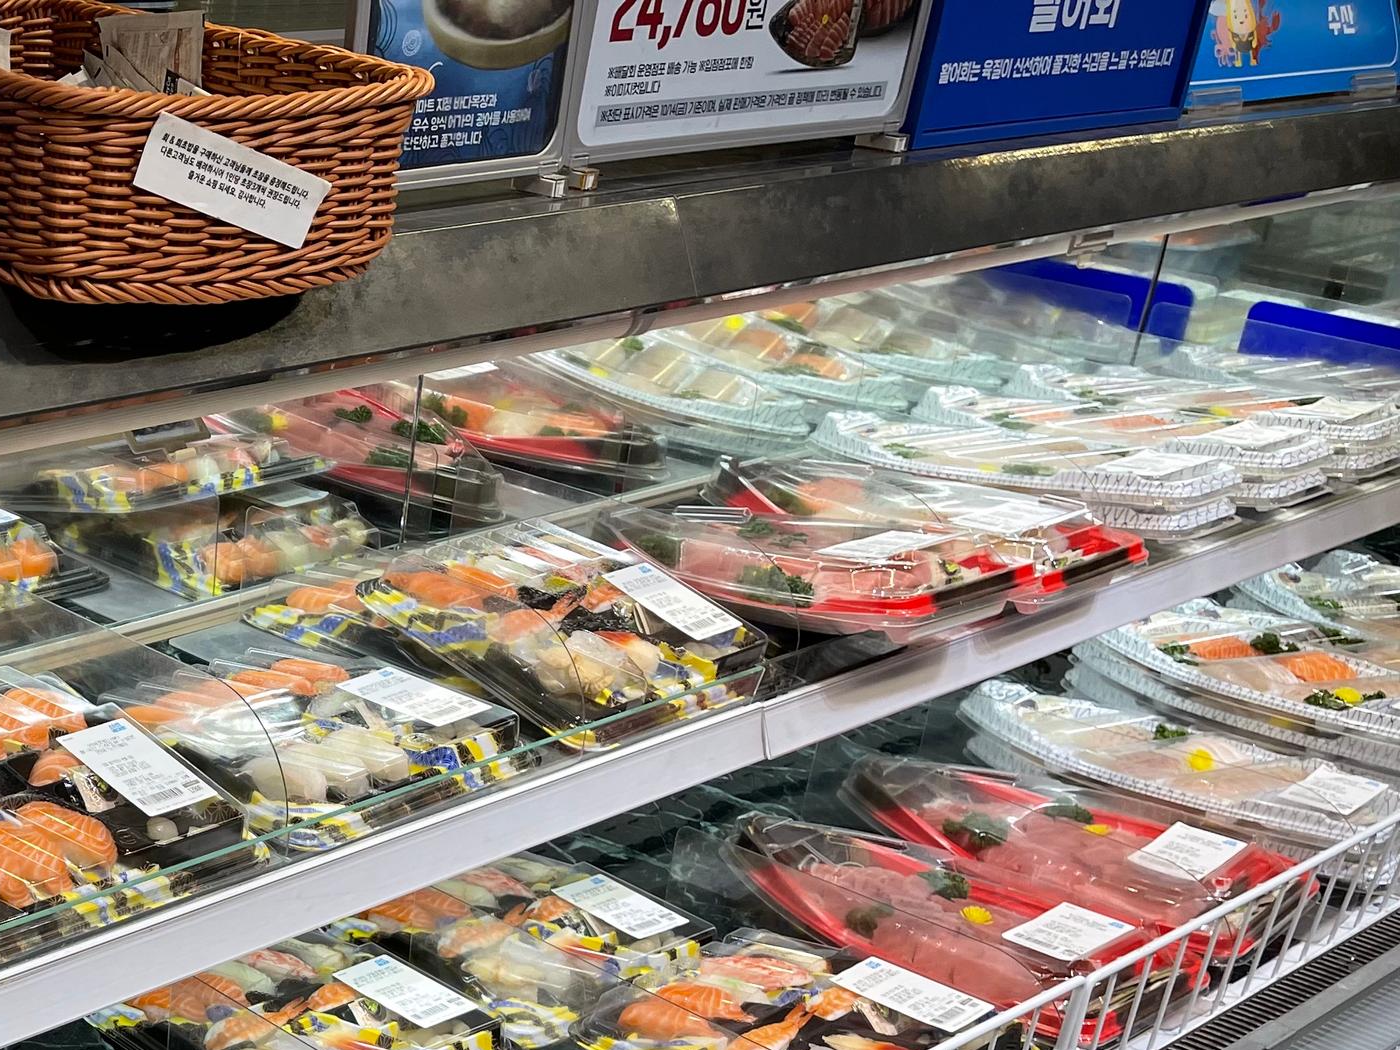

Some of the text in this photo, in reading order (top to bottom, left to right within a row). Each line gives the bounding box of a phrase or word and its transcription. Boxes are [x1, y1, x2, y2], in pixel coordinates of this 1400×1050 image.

[1328, 4, 1357, 36] 수산
[938, 47, 1175, 85] 활어회는 육질이 신선하여 쫄깃한 식감을 느낄 수 있습니다
[436, 97, 452, 111] 지정
[453, 93, 497, 110] 바다목장과
[412, 117, 429, 132] 우수
[431, 116, 447, 131] 양식
[403, 130, 482, 151] 단단하고 쫄깃합니다
[200, 147, 224, 165] 구매하신
[188, 170, 205, 185] 즐거운
[206, 175, 217, 190] 쇼핑
